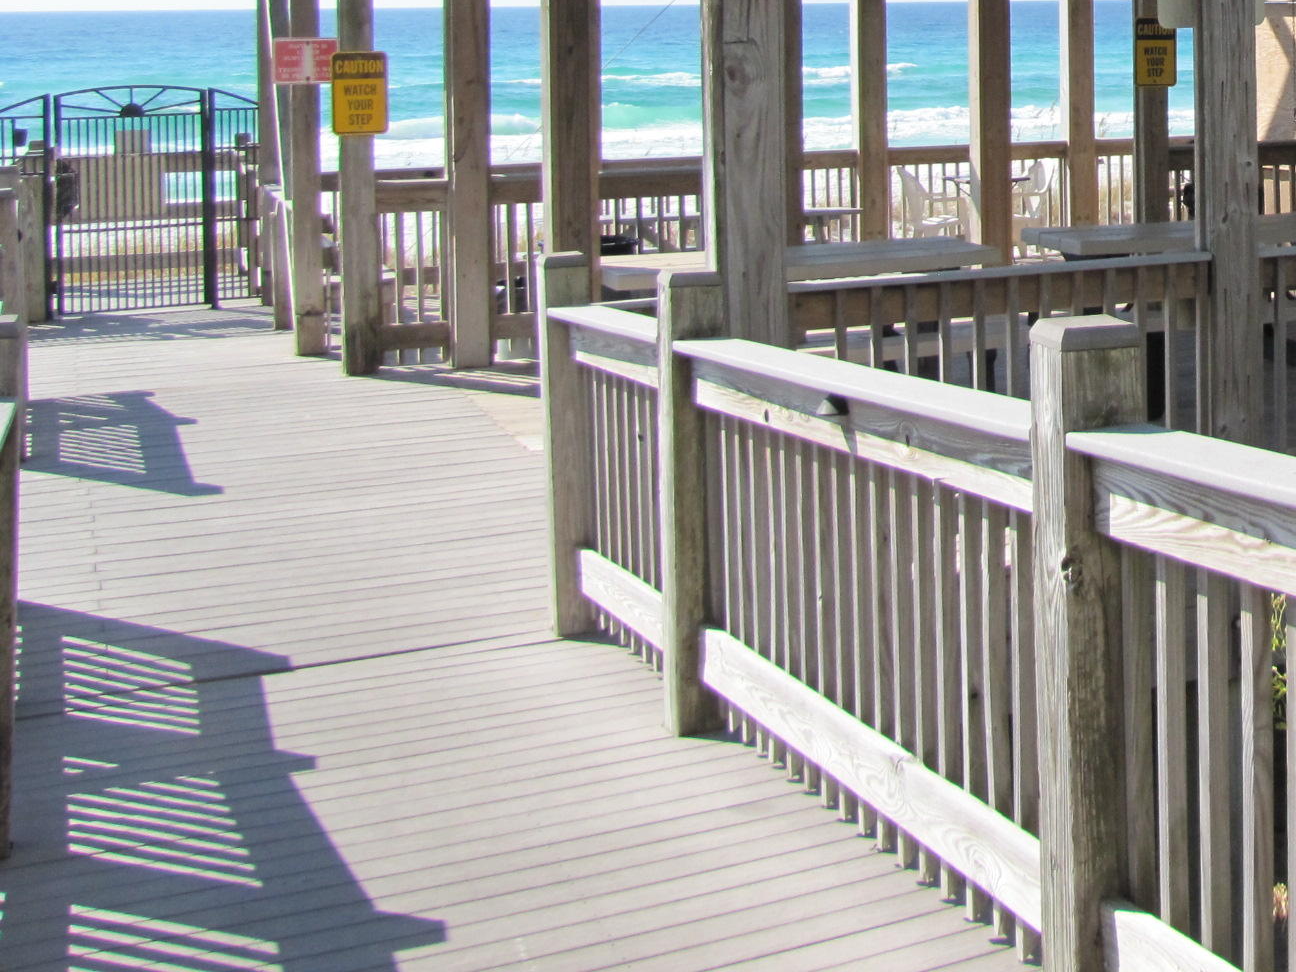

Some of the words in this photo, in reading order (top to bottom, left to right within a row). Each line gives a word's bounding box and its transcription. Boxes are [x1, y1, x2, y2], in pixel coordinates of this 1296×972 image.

[1137, 24, 1175, 35] CAUTION
[335, 60, 383, 73] CAUTION
[1146, 57, 1165, 66] YOUR
[1147, 68, 1164, 77] STEP
[344, 84, 377, 96] WATCH
[347, 99, 374, 111] YOUR
[348, 113, 373, 125] STEP
